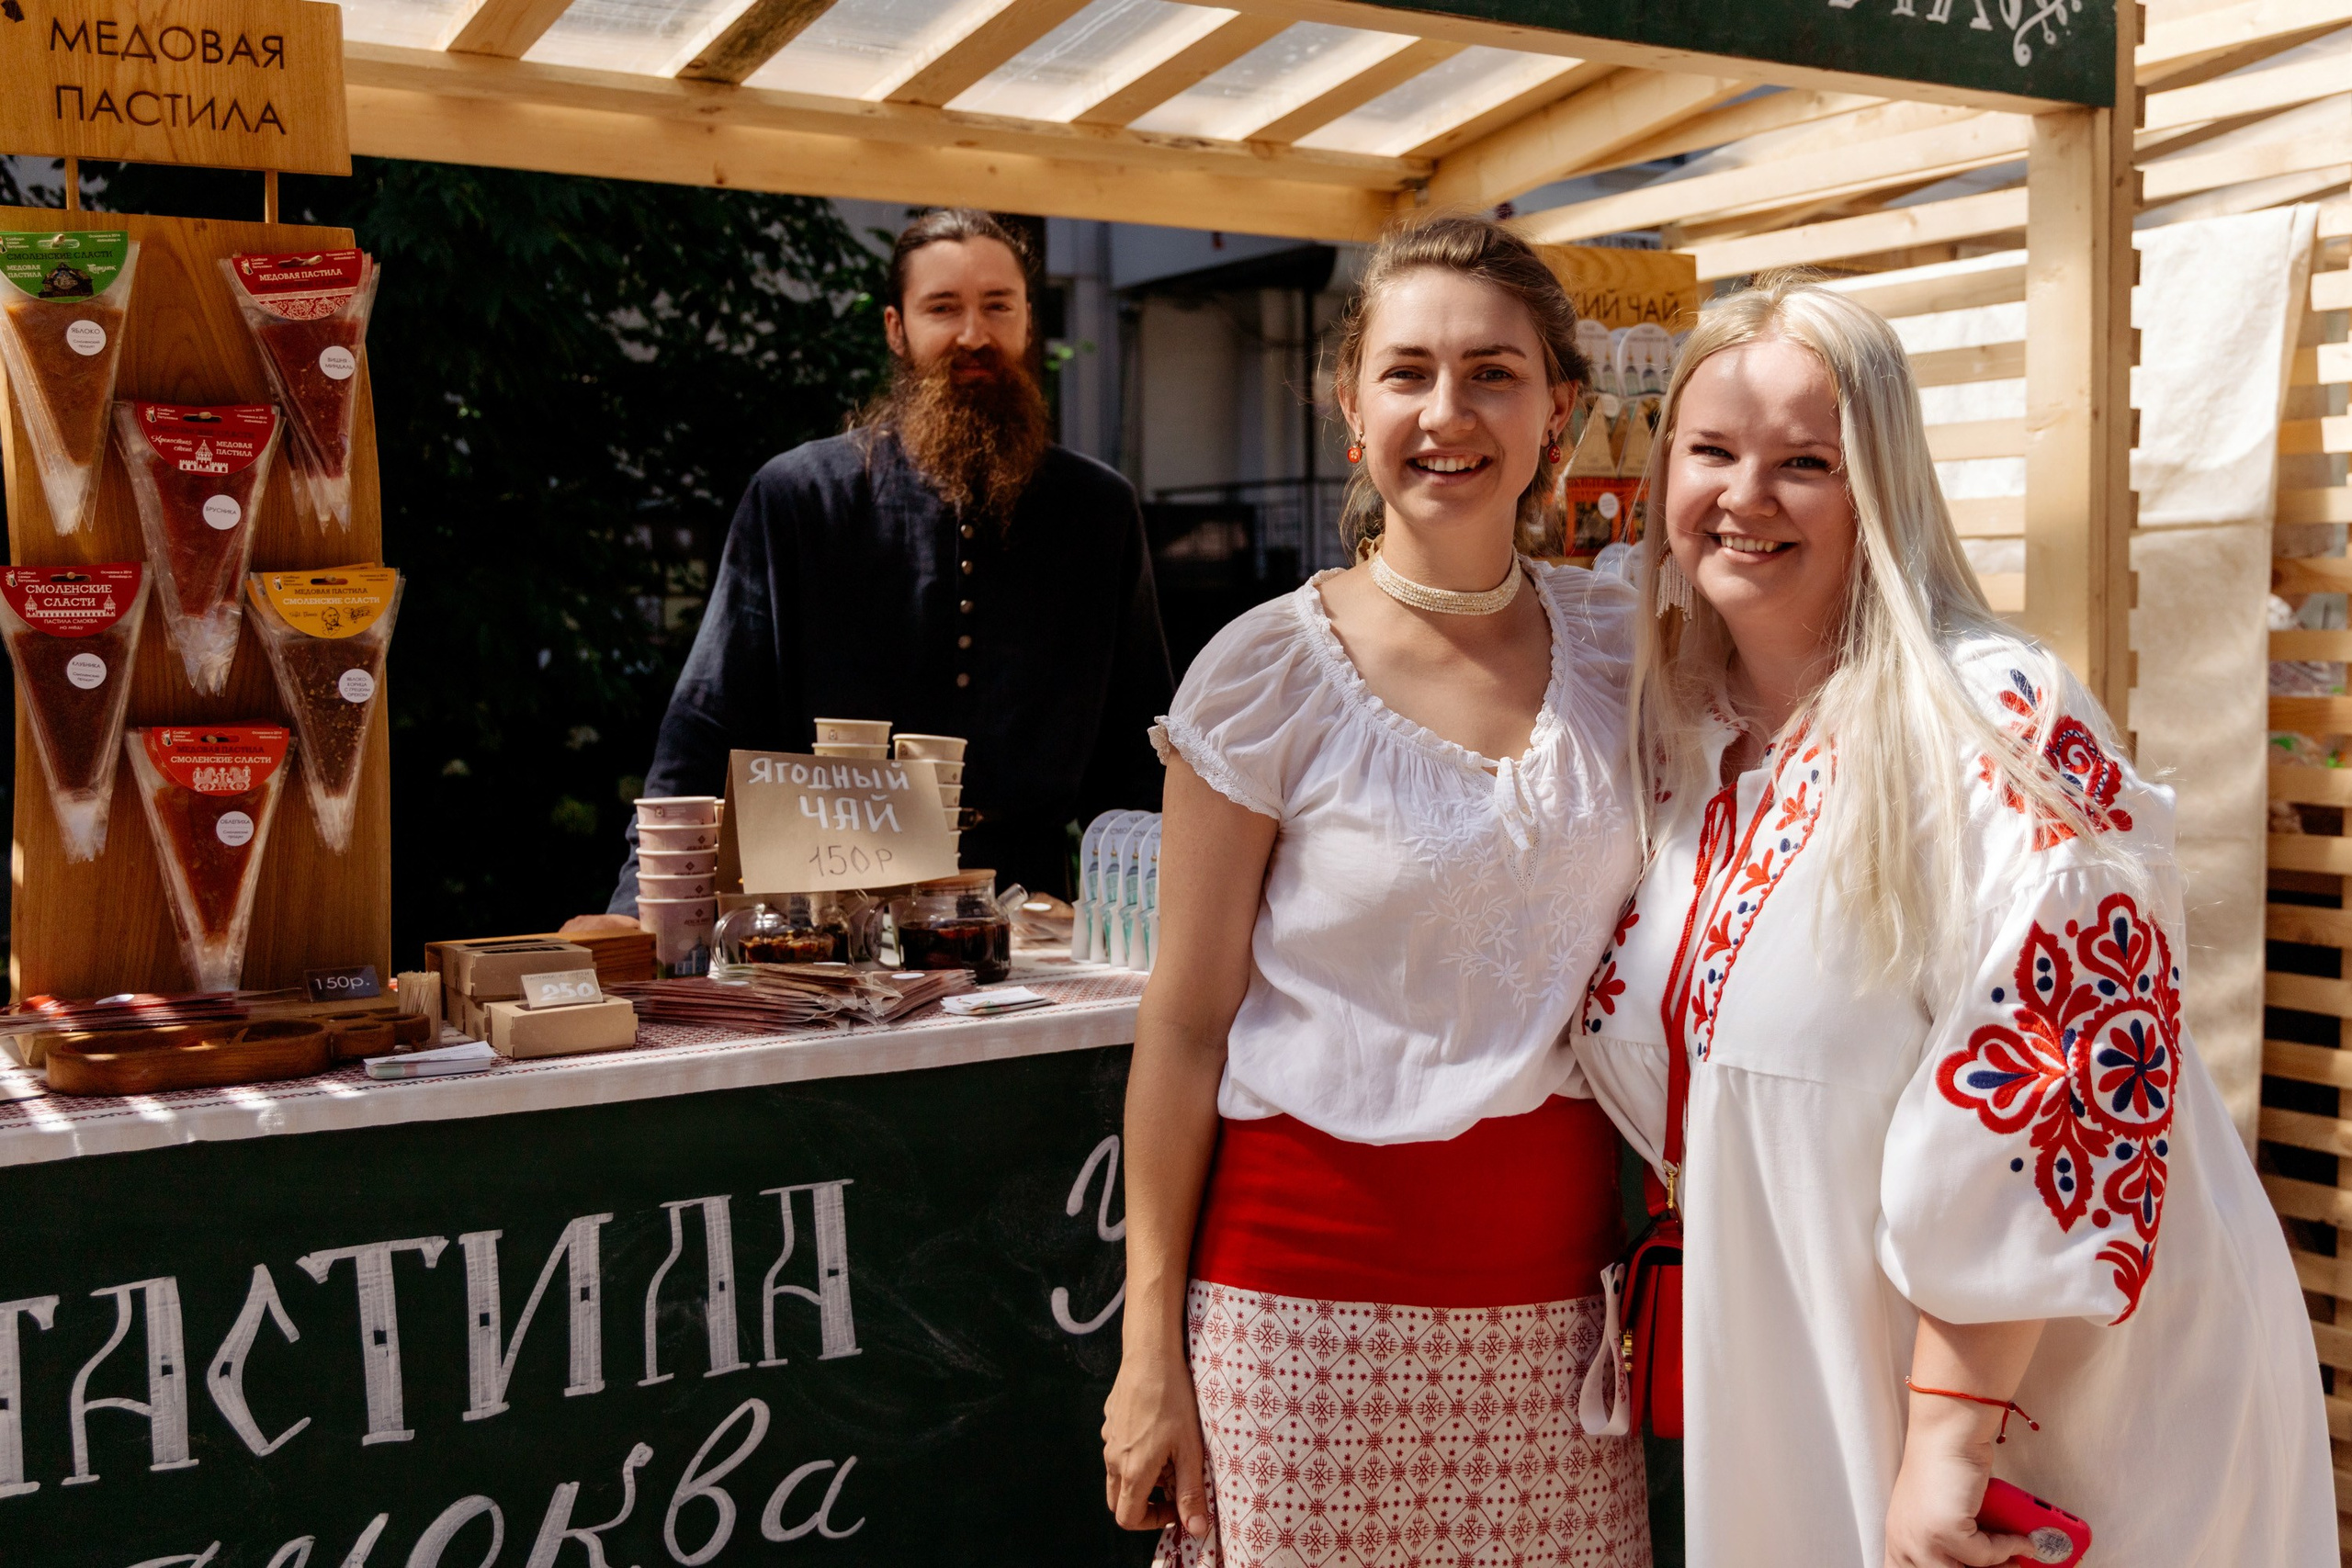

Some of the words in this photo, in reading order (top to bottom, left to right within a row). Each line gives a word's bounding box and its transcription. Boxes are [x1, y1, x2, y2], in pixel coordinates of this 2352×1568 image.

[50, 17, 285, 70] МЕДОВАЯ
[55, 85, 287, 135] ПАСТИЛА
[6, 252, 72, 261] СМОЛЕНСКИЕ
[74, 250, 113, 258] СЛАСТИ
[259, 271, 300, 282] МЕДОВАЯ
[300, 268, 343, 278] ПАСТИЛА
[1627, 290, 1680, 323] ЧАЙ
[216, 440, 253, 449] МЕДОВАЯ
[216, 448, 253, 457] ПАСТИЛА
[205, 506, 237, 515] БРУСНИКА
[26, 584, 112, 594] СМОЛЕНСКИЕ
[294, 588, 331, 596] МЕДОВАЯ
[332, 587, 368, 595] ПАСТИЛА
[43, 597, 96, 607] СЛАСТИ
[282, 597, 343, 605] СМОЛЕНСКИЕ
[344, 596, 380, 604] СЛАСТИ
[72, 660, 101, 669] КЛУБНИКА
[175, 746, 220, 754] МЕДОВАЯ
[220, 745, 265, 753] ПАСТИЛА
[170, 756, 232, 764] СМОЛЕНСКИЕ
[234, 756, 272, 764] СЛАСТИ
[798, 794, 903, 833] ЧАЙ
[540, 982, 596, 1001] 250
